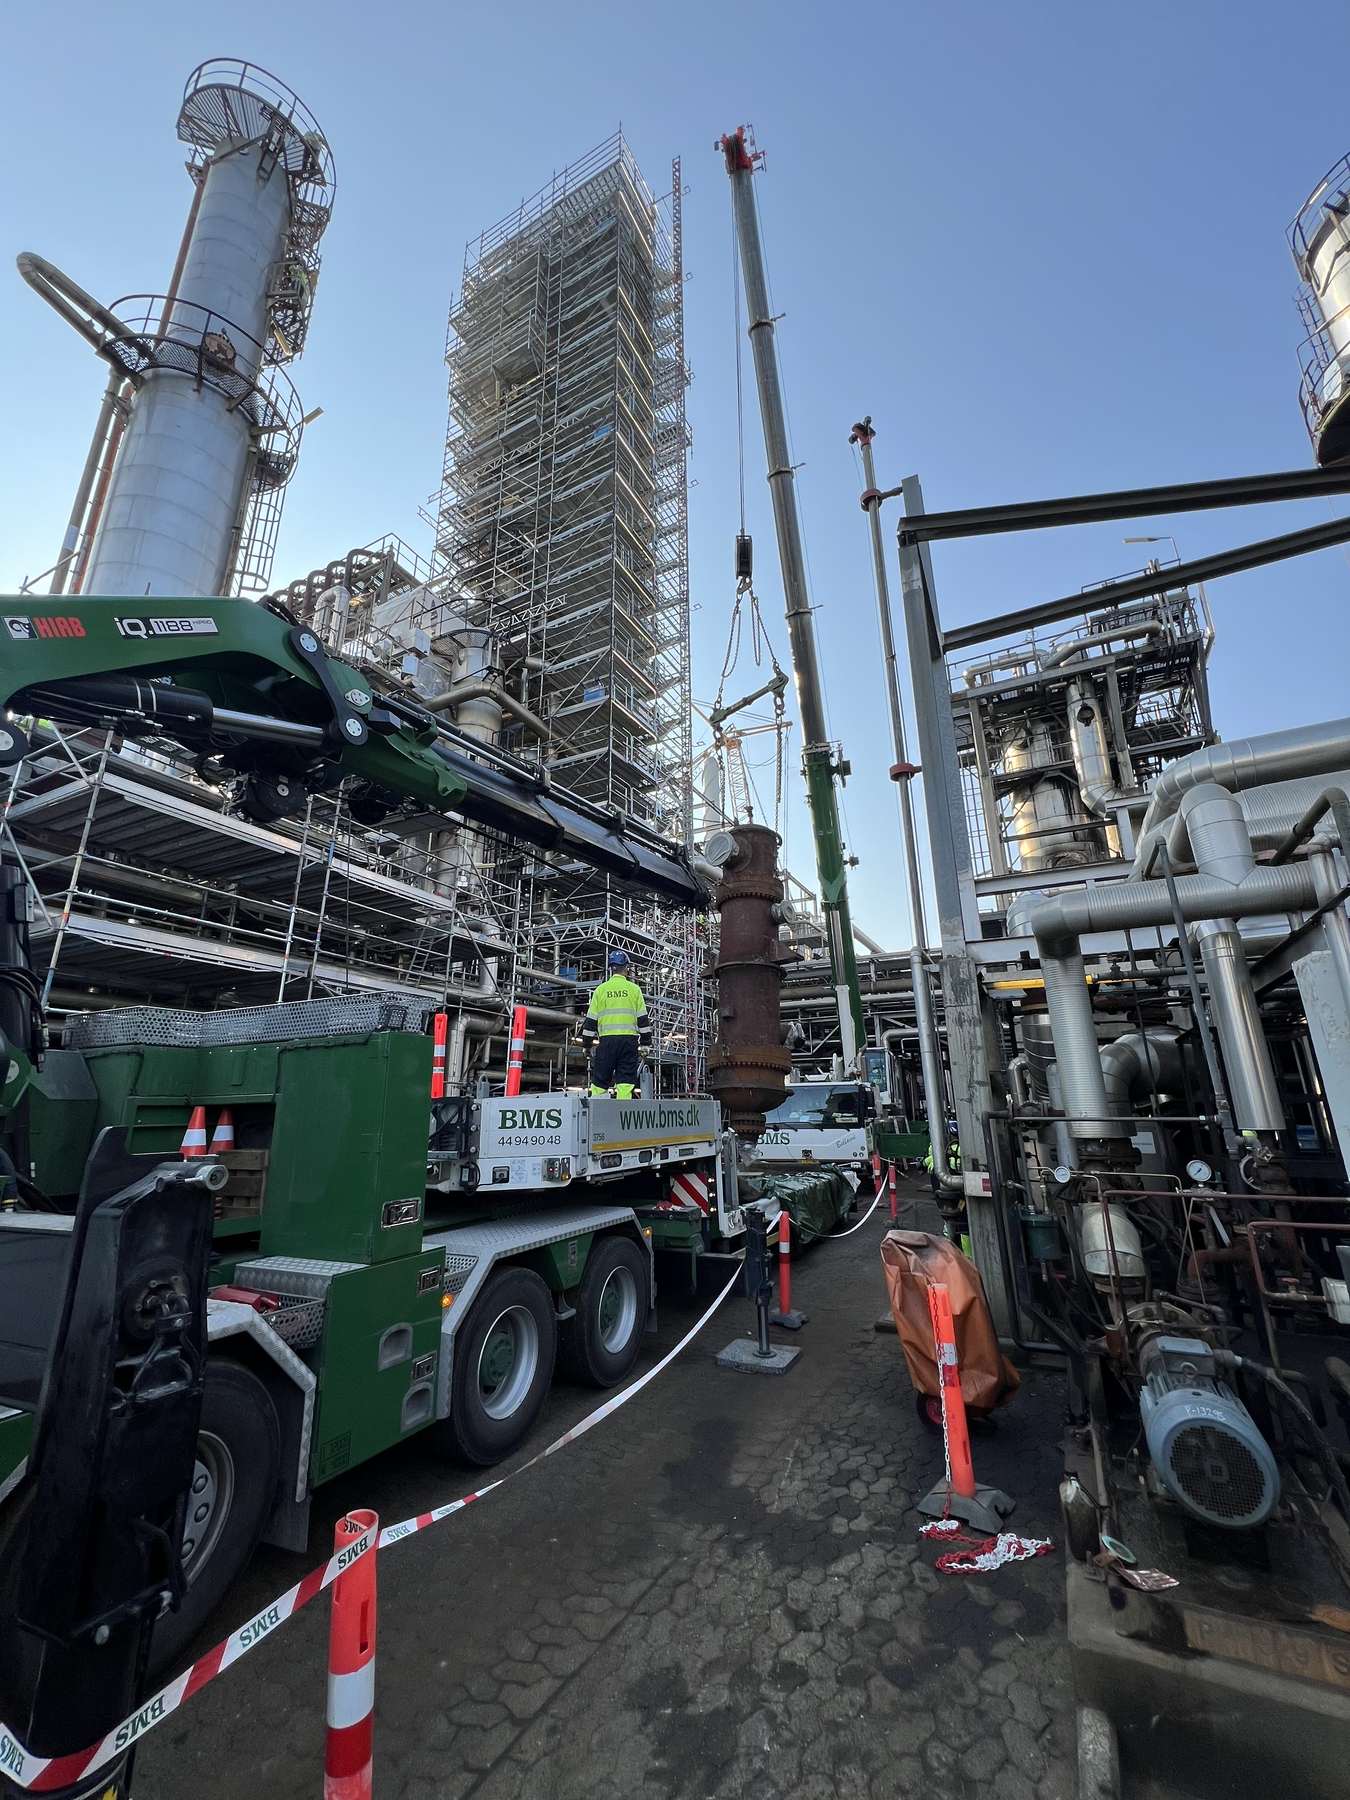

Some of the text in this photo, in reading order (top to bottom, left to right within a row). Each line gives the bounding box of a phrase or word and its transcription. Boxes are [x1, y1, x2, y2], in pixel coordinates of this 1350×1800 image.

[33, 617, 86, 637] HIAB
[607, 990, 628, 998] BMS
[498, 1109, 562, 1129] BMS
[620, 1104, 699, 1130] www.bms.dk
[387, 1525, 411, 1540] BMS
[338, 1535, 369, 1570] BMS
[240, 1605, 280, 1647] BMS
[115, 1694, 165, 1751] BMS
[0, 1735, 25, 1776] BMS
